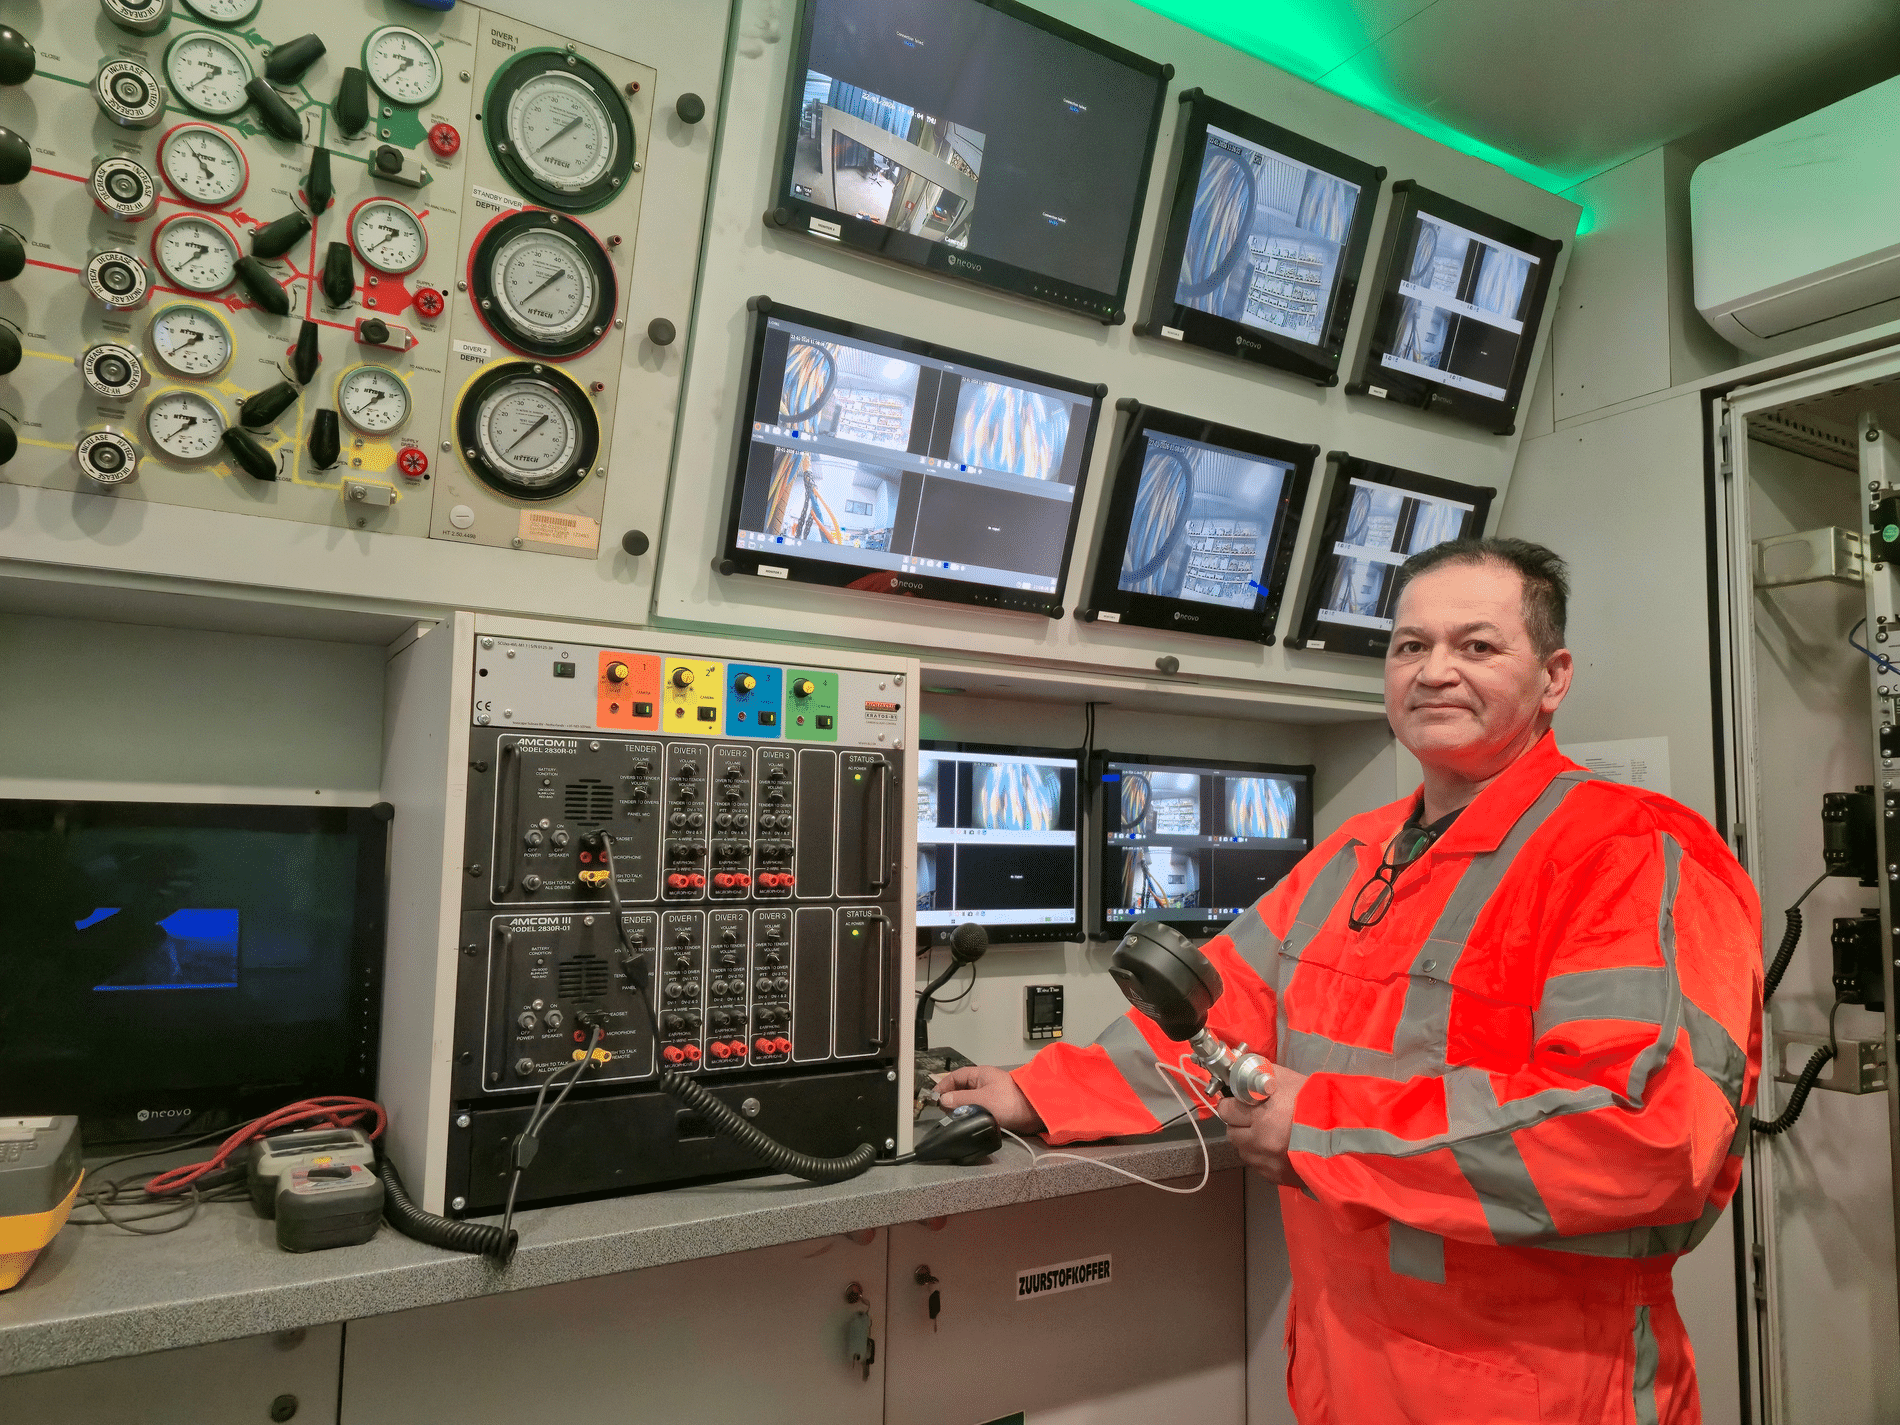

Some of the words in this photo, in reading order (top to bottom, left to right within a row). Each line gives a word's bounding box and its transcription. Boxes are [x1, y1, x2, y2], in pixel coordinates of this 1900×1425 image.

[121, 7, 156, 18] DECREASE
[491, 29, 514, 42] DIVER
[492, 39, 516, 52] DEPTH
[40, 52, 60, 61] CLOSE
[108, 64, 144, 76] INCREASE
[108, 98, 144, 116] DECREASE
[36, 148, 56, 156] CLOSE
[97, 168, 110, 200] DECREASE
[132, 166, 152, 197] INCREASE
[473, 188, 502, 201] STANDBY
[503, 196, 522, 208] DIVER
[476, 200, 500, 212] DEPTH
[32, 240, 51, 250] CLOSE
[97, 254, 132, 265] DECREASE
[956, 258, 982, 272] neovo
[111, 288, 142, 302] INCREASE
[463, 344, 482, 353] DIVER
[1242, 339, 1262, 350] neovo
[86, 348, 104, 375] DECREASE
[460, 354, 484, 364] DEPTH
[128, 359, 141, 390] INCREASE
[81, 435, 108, 453] INCREASE
[98, 467, 130, 481] DECREASE
[899, 580, 923, 590] neovo
[517, 738, 565, 747] AMCOM
[625, 745, 656, 753] TENDER
[510, 918, 559, 926] AMCOM
[151, 1106, 192, 1120] neovo
[1018, 1260, 1110, 1296] ZUURSTOFKOFFER
